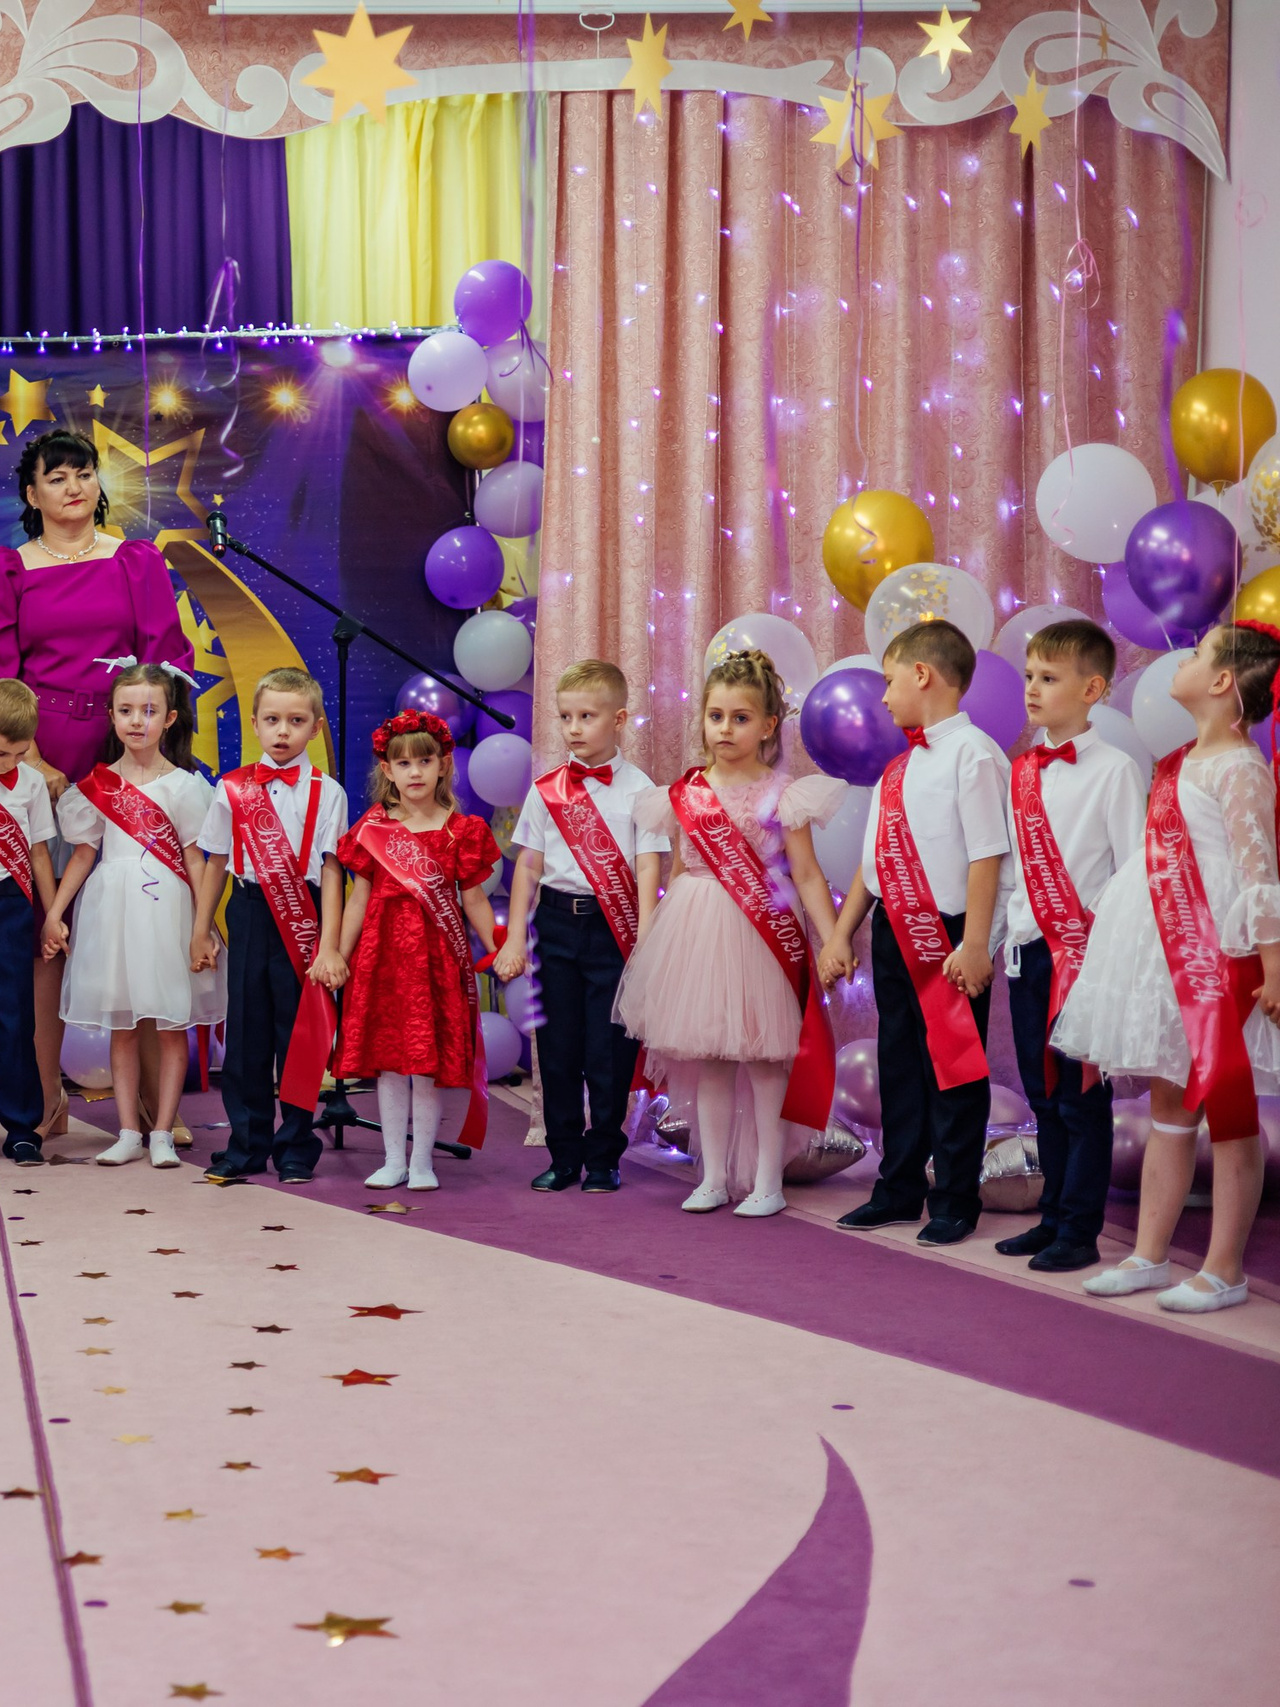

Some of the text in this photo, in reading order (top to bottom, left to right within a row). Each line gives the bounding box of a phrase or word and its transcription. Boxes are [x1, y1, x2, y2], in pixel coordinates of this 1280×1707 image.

[6, 858, 22, 876] сада
[239, 822, 262, 862] детского
[257, 861, 272, 885] сада
[252, 807, 304, 918] Выпускник
[570, 843, 601, 883] детского
[598, 884, 612, 906] сада
[688, 829, 720, 866] детского
[718, 865, 736, 886] сада
[876, 846, 887, 870] сада
[1014, 808, 1027, 853] детского
[1022, 852, 1033, 878] сада
[293, 874, 306, 901] Роман
[699, 807, 806, 963] Выпускница 2024
[885, 788, 947, 963] Выпускник 2024
[1023, 791, 1088, 971] Выпускник 2024
[1158, 807, 1225, 1004] Выпускница 2024
[435, 912, 449, 933] сада
